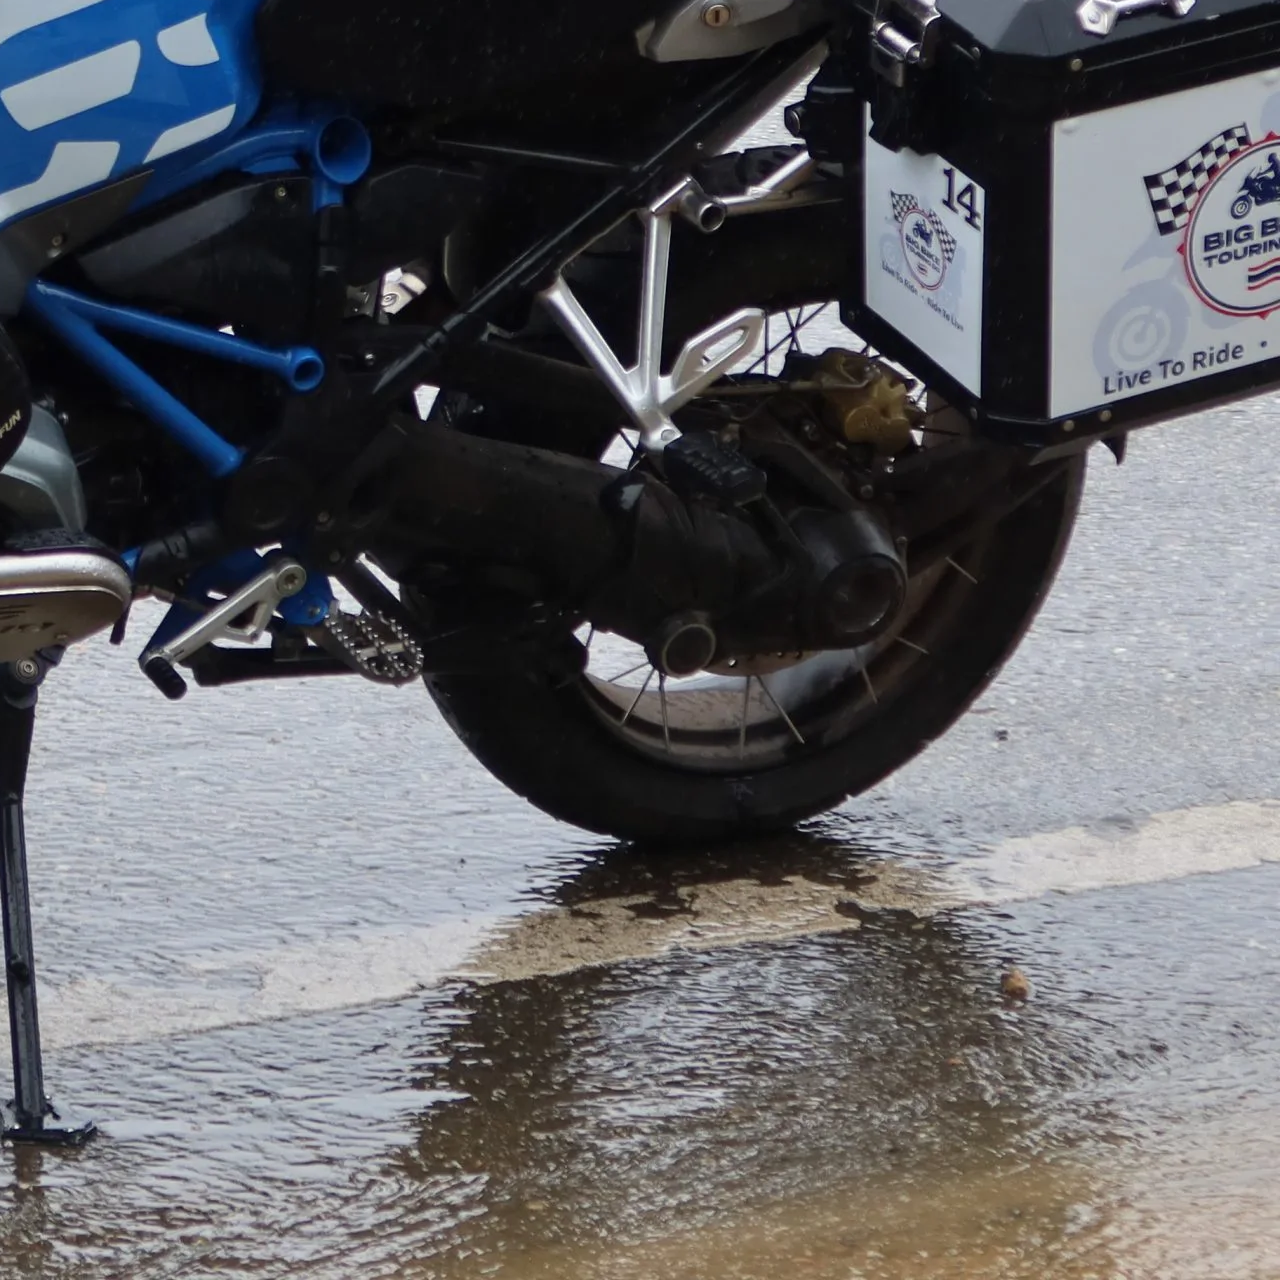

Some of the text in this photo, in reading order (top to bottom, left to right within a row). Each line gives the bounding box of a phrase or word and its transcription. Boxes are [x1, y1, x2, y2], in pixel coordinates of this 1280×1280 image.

[942, 167, 981, 232] 14
[1204, 224, 1256, 253] BIG
[1103, 342, 1244, 395] Live To Ride
[0, 409, 21, 439] FUN
